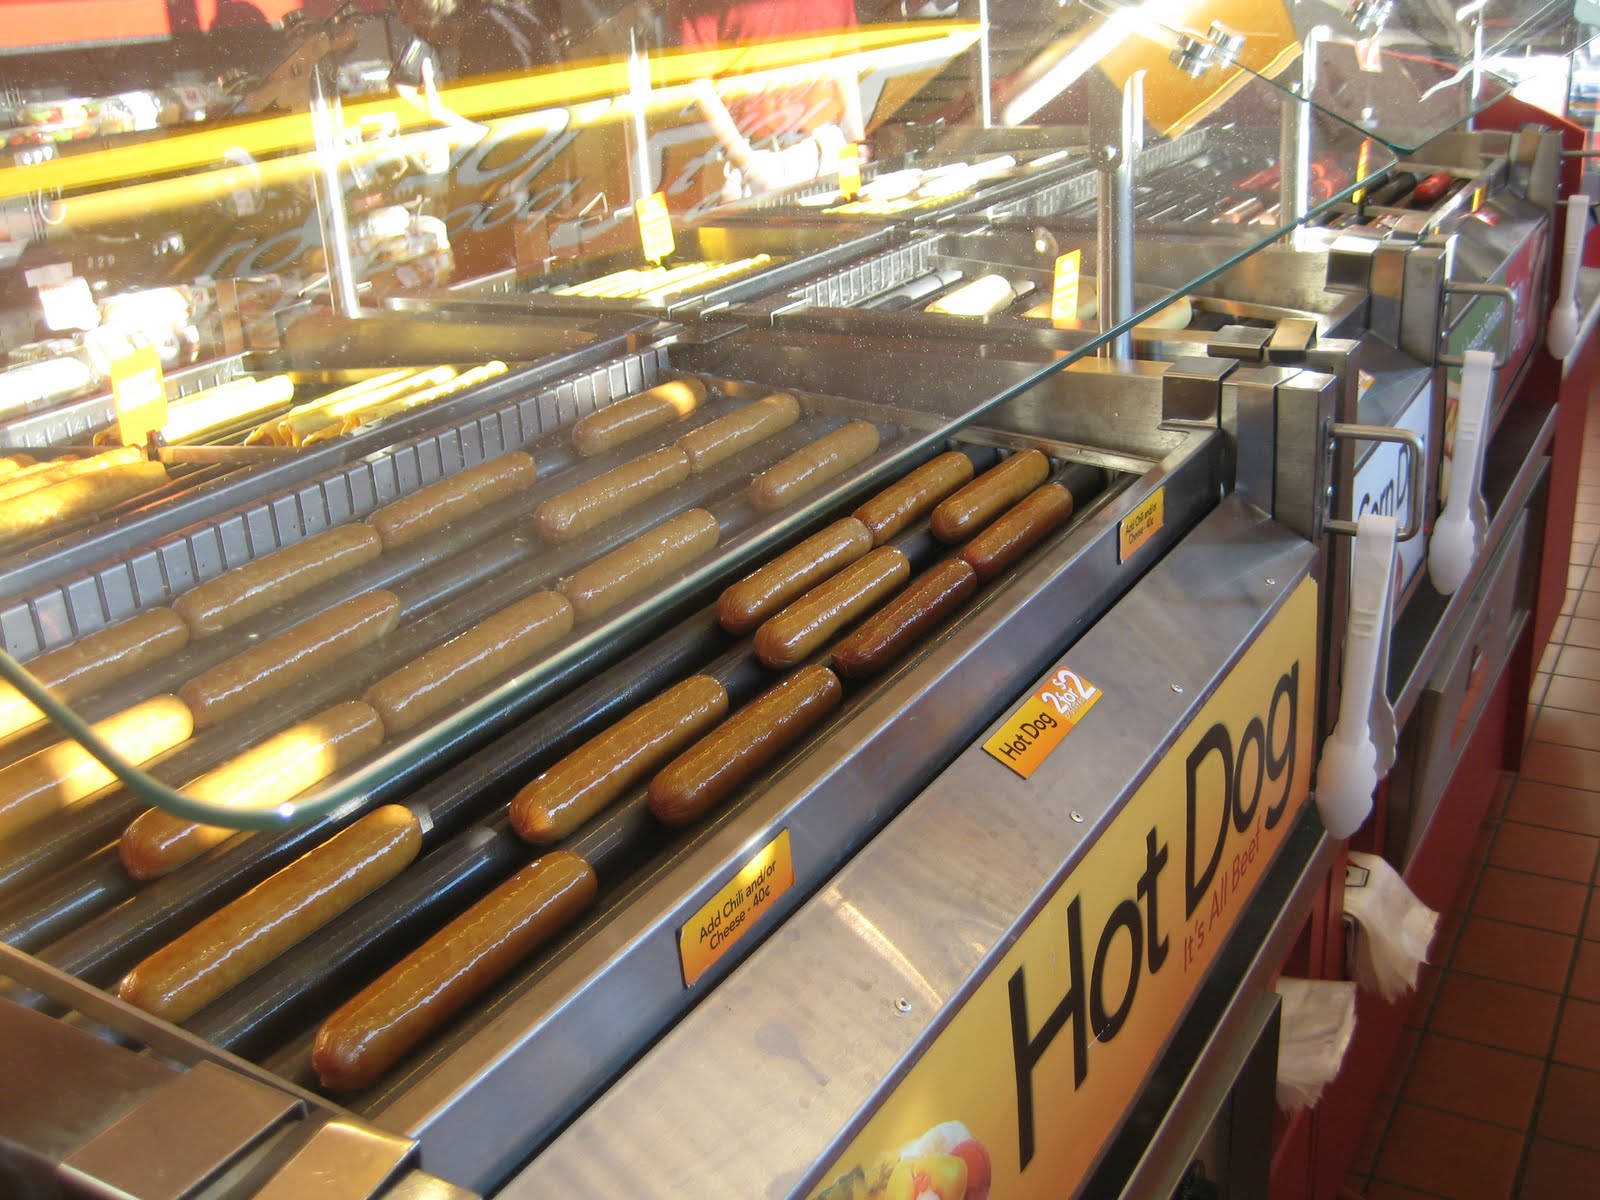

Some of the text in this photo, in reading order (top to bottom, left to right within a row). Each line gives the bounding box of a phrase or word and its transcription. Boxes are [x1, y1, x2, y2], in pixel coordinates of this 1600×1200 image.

[998, 711, 1058, 761] Hot Dog
[699, 860, 777, 943] Add Chili and/or
[709, 910, 746, 950] Cheese
[1007, 661, 1300, 1173] Hot Dog
[1184, 815, 1261, 973] It's All Beef
